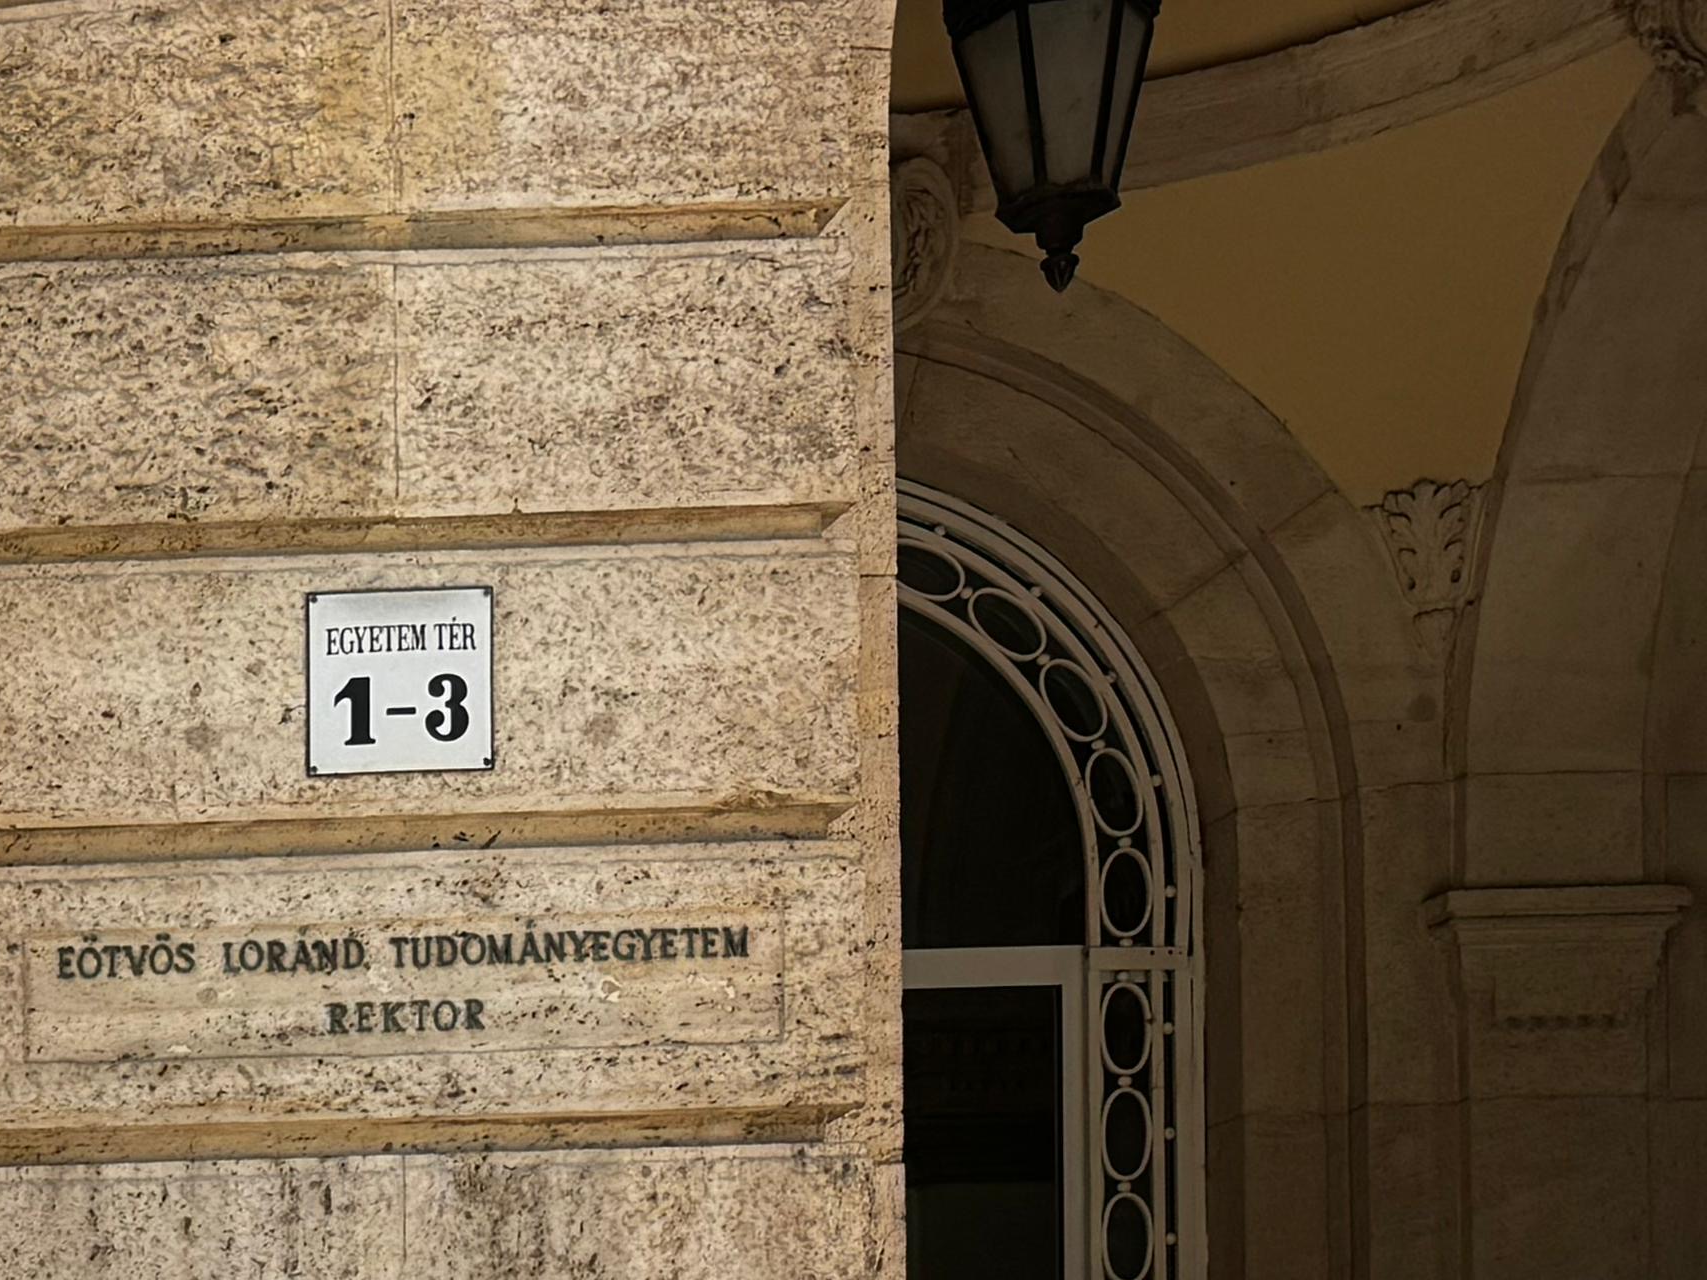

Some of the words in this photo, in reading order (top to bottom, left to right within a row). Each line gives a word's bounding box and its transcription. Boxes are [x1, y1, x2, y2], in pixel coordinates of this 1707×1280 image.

[325, 624, 427, 655] EGYETEM
[434, 616, 477, 651] TÉR
[333, 673, 470, 746] 1-3
[56, 932, 197, 979] EÖTVÖS
[222, 925, 366, 973] LORÁND
[388, 920, 750, 969] TUDOMÁNYEGYETEM
[325, 998, 486, 1035] REKTOR
